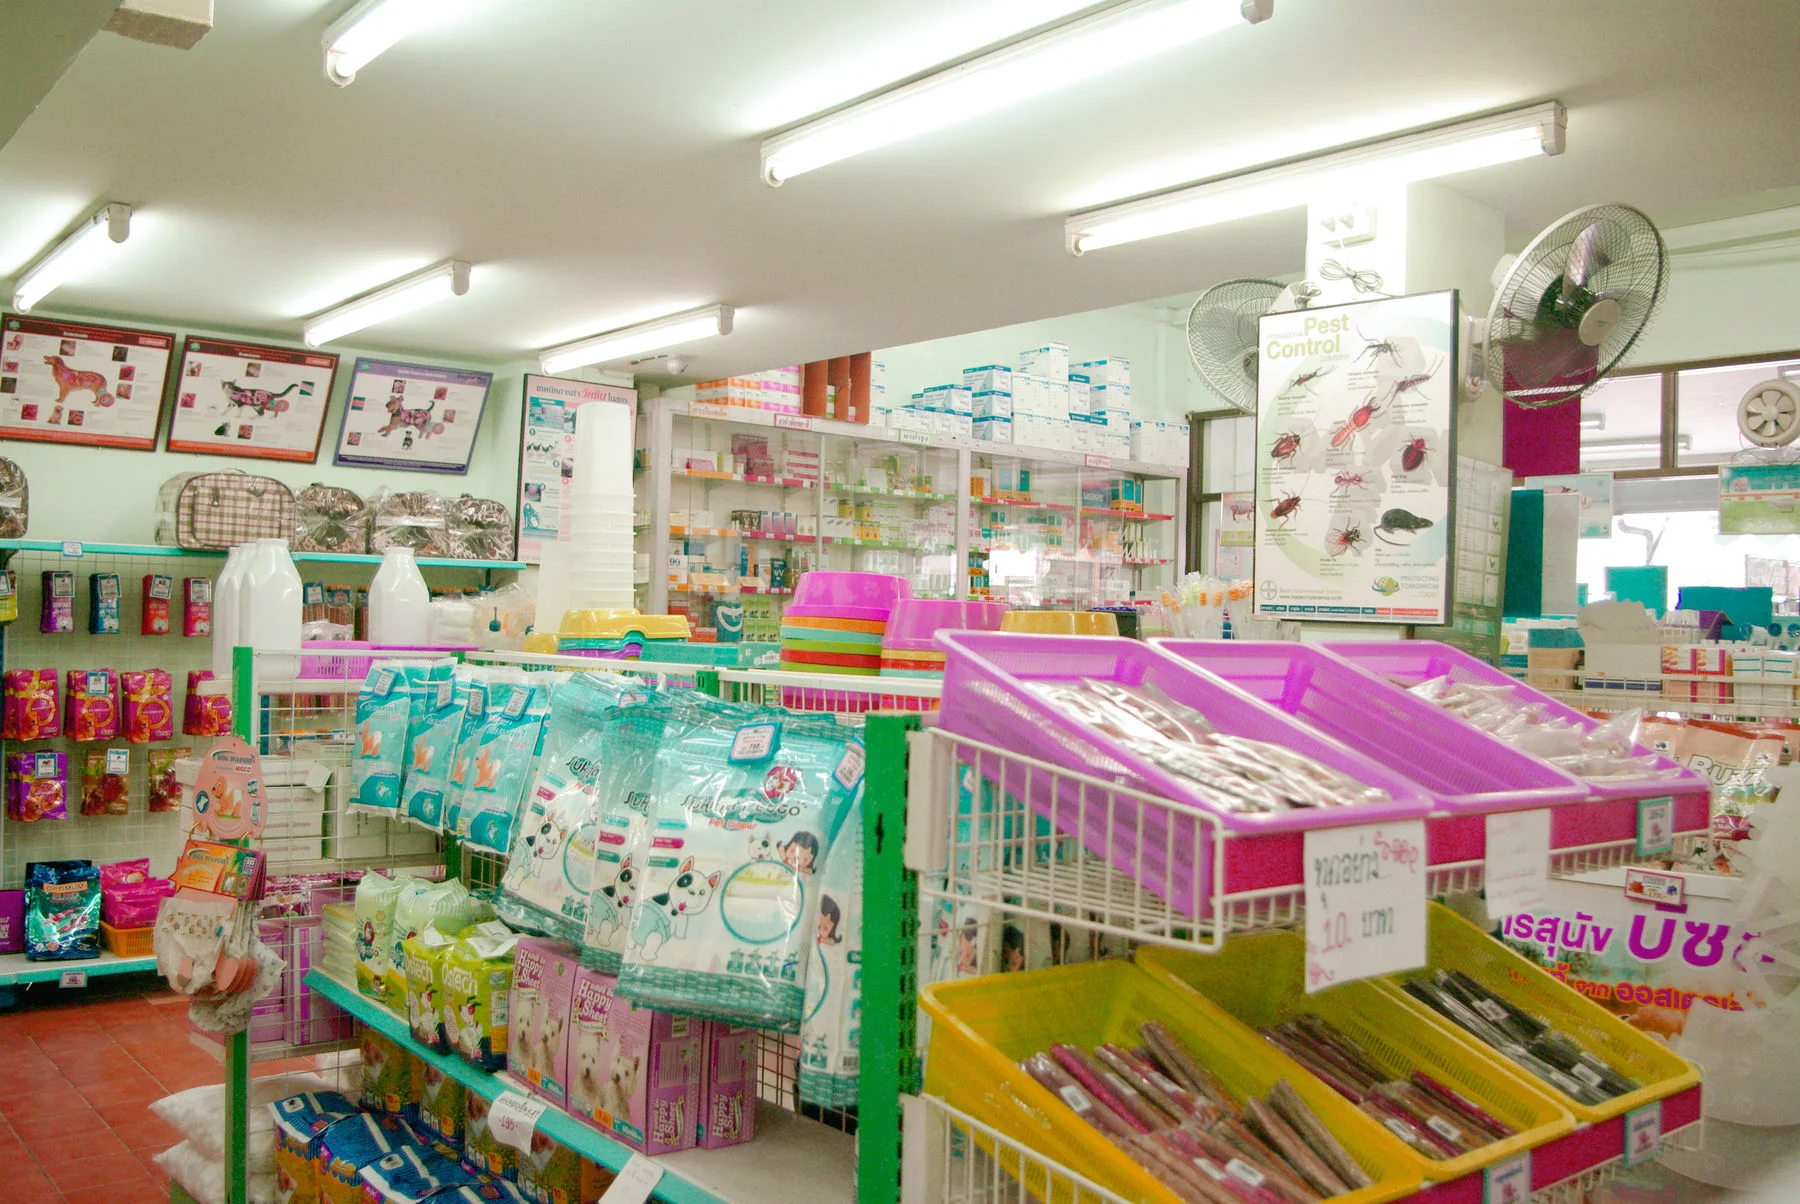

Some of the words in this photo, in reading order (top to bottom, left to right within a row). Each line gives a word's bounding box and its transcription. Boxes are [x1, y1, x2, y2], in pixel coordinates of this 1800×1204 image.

[1304, 314, 1350, 336] Pest
[1267, 335, 1341, 360] Control
[708, 818, 724, 827] Pet
[727, 820, 757, 830] Diaper
[517, 949, 545, 977] Happy
[519, 969, 541, 990] Sheet
[578, 979, 613, 1011] Happy
[578, 999, 609, 1025] Sheet
[653, 1099, 668, 1145] Happy
[665, 1101, 676, 1134] Sheet
[711, 1095, 727, 1137] Happy
